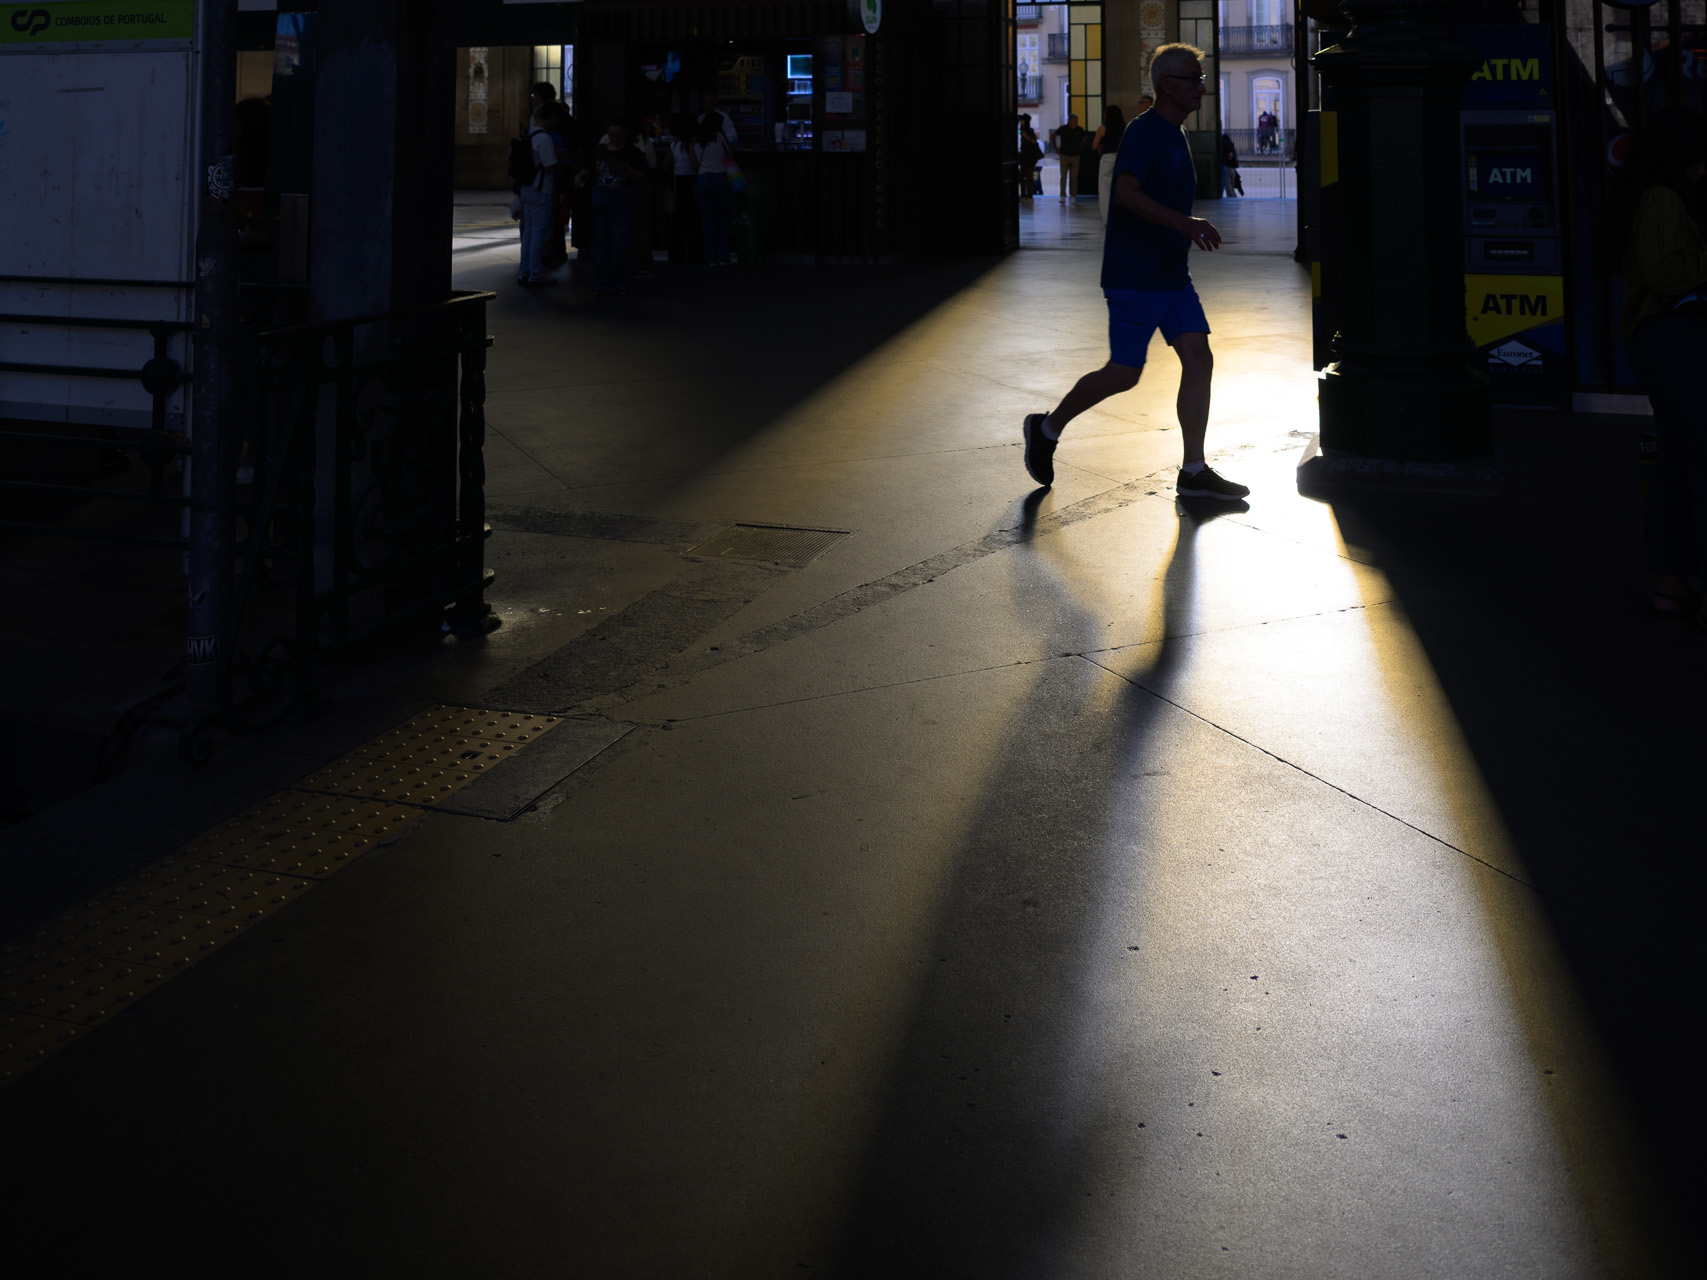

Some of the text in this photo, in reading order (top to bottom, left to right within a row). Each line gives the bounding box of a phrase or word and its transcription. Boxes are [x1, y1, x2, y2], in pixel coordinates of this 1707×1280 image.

[55, 13, 166, 27] COMBOIOS DE PORTUGAL
[1471, 58, 1540, 81] ATM
[1488, 167, 1532, 184] ATM
[1481, 293, 1547, 316] ATM
[1496, 348, 1533, 358] Euronet
